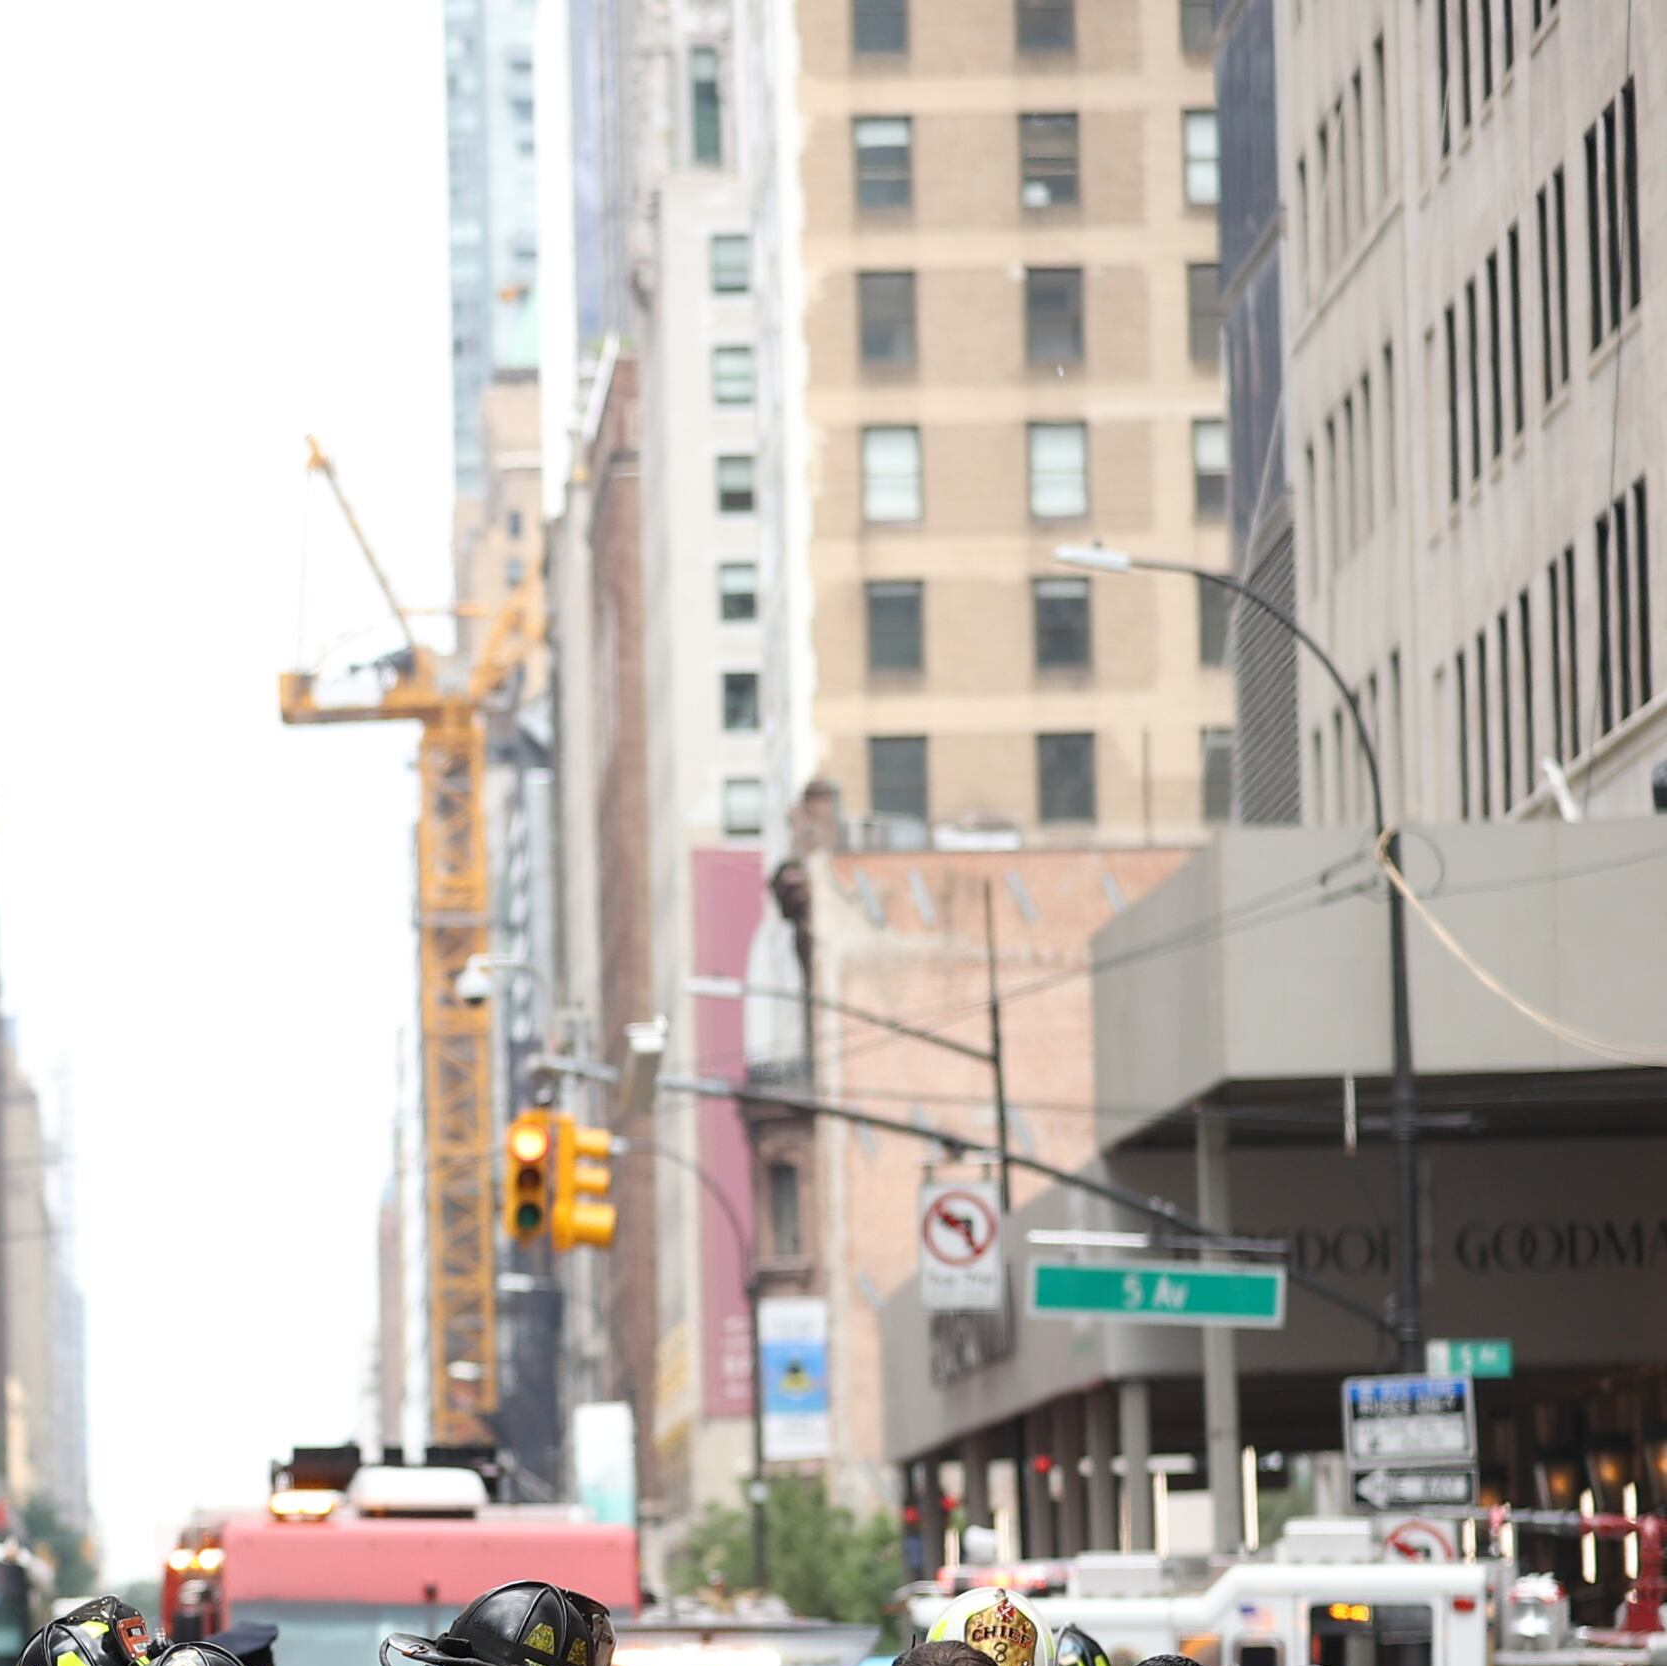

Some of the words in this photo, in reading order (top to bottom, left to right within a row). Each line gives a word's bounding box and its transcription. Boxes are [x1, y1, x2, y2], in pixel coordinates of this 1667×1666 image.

[1123, 1274, 1144, 1309] 5
[1153, 1275, 1189, 1310] Av
[972, 1625, 1030, 1648] CHIEF
[993, 1642, 1007, 1663] 8
